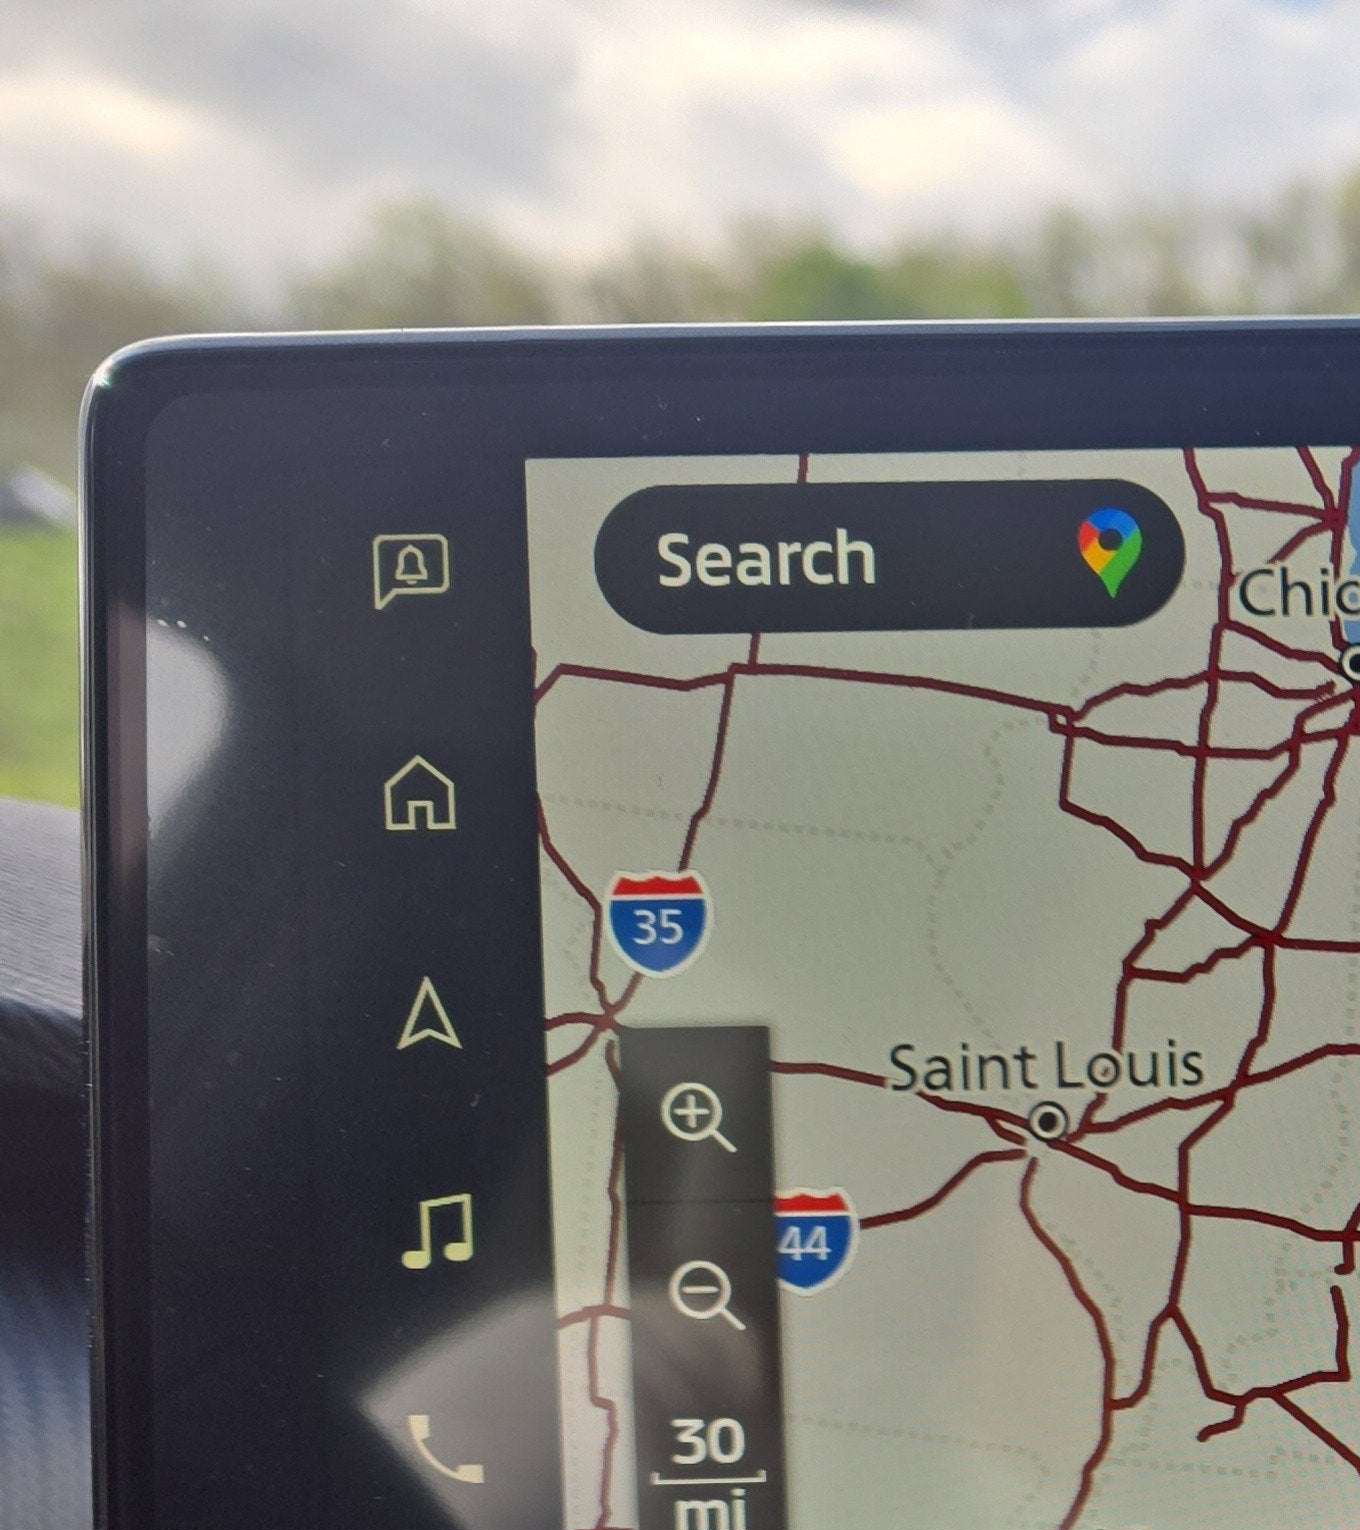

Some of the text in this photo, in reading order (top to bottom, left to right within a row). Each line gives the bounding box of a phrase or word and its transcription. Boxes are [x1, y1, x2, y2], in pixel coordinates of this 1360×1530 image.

[657, 528, 877, 587] Search
[632, 908, 684, 946] 35
[888, 1043, 1204, 1090] Saint Louis
[778, 1226, 832, 1262] 44
[671, 1417, 746, 1465] 30
